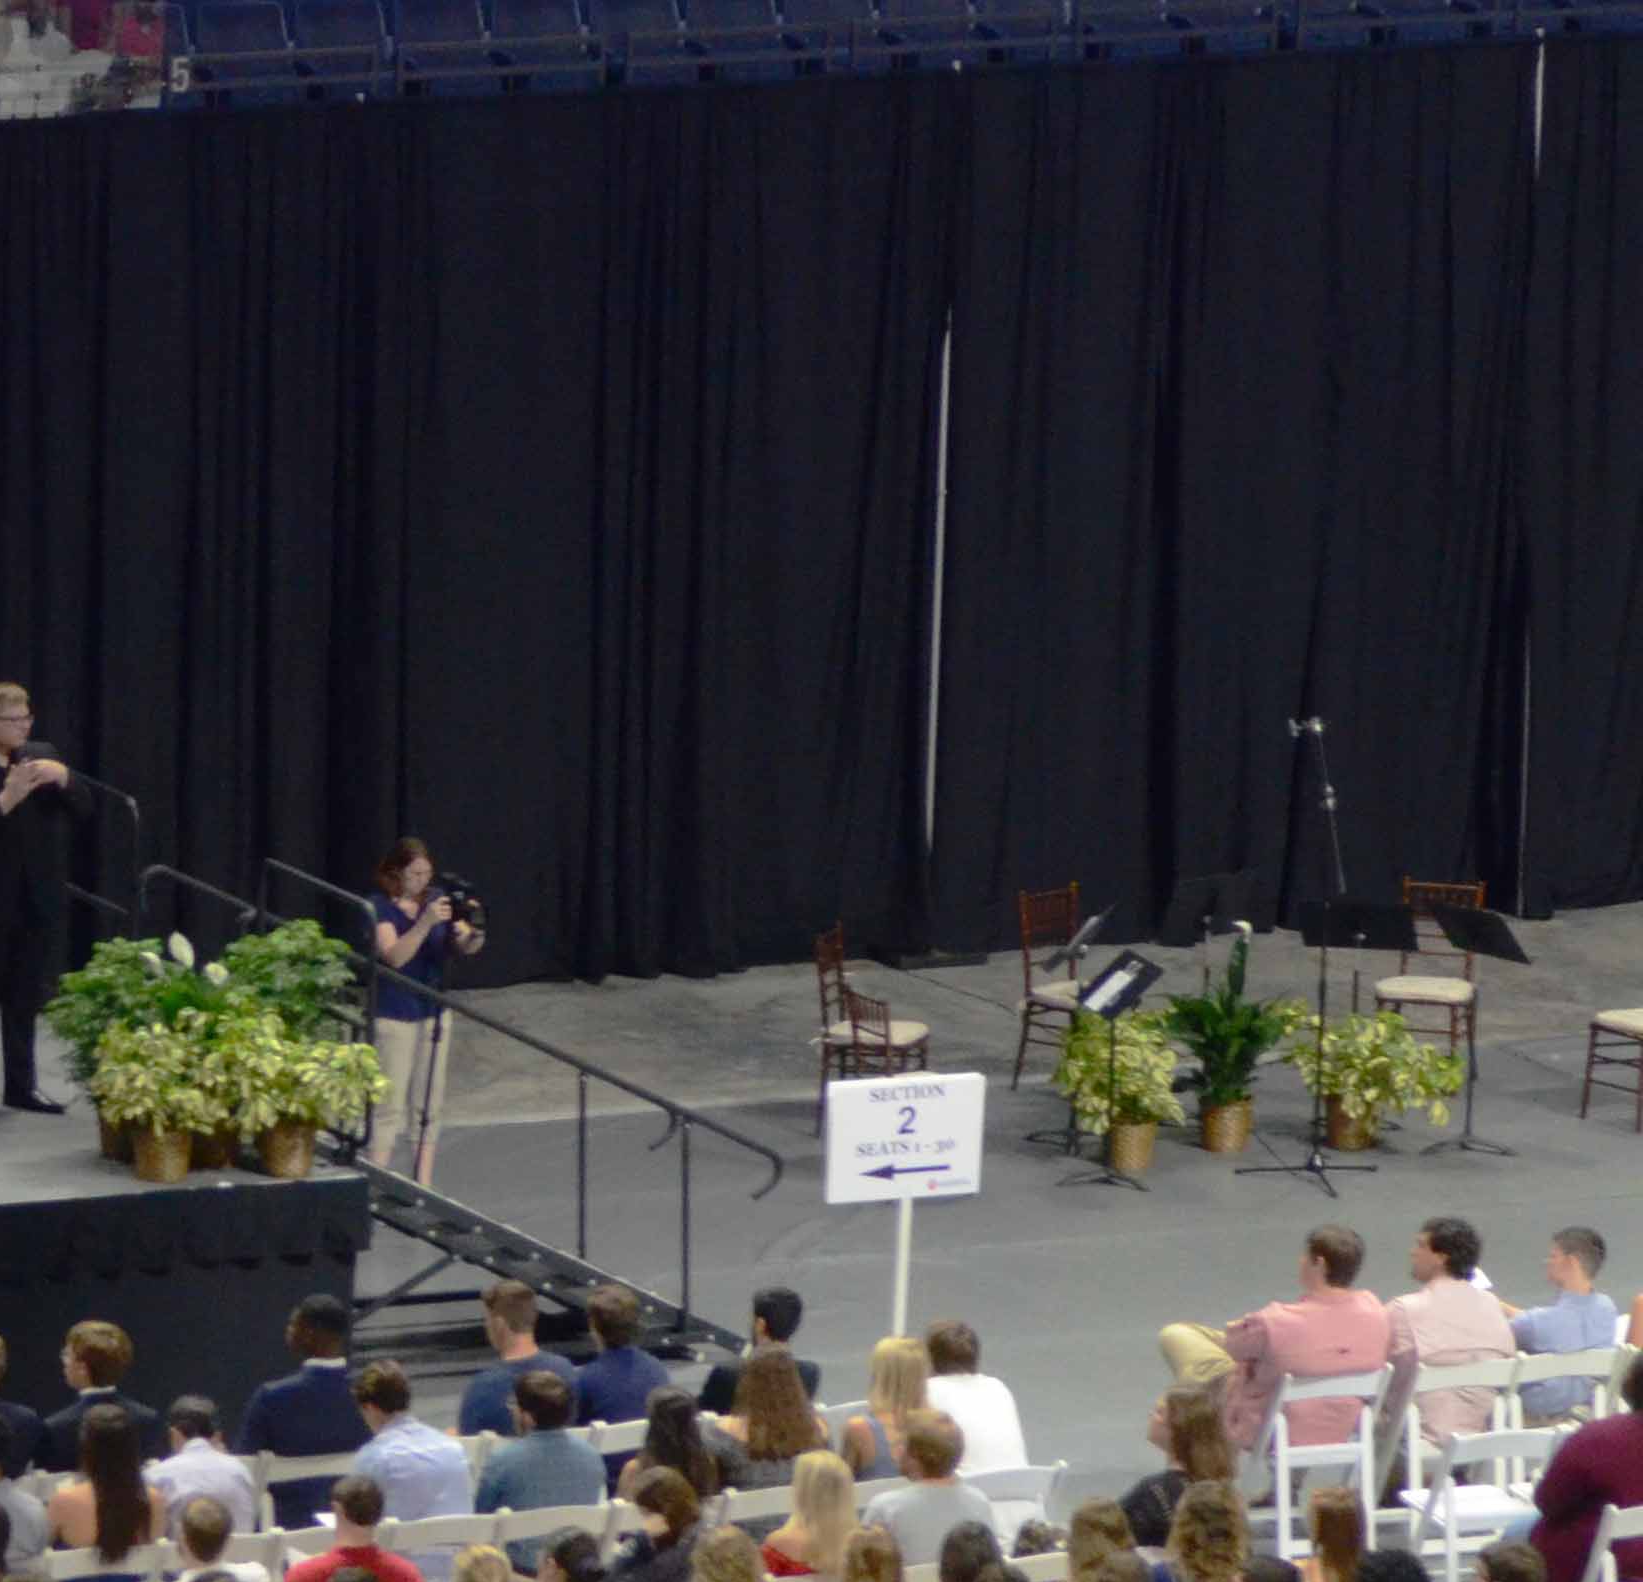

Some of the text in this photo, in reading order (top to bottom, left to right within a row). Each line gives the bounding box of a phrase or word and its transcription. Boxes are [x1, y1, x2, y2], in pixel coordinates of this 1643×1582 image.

[171, 57, 190, 93] 5
[868, 1083, 946, 1103] SECTION
[896, 1105, 918, 1135] 2
[855, 1140, 909, 1157] SEATS
